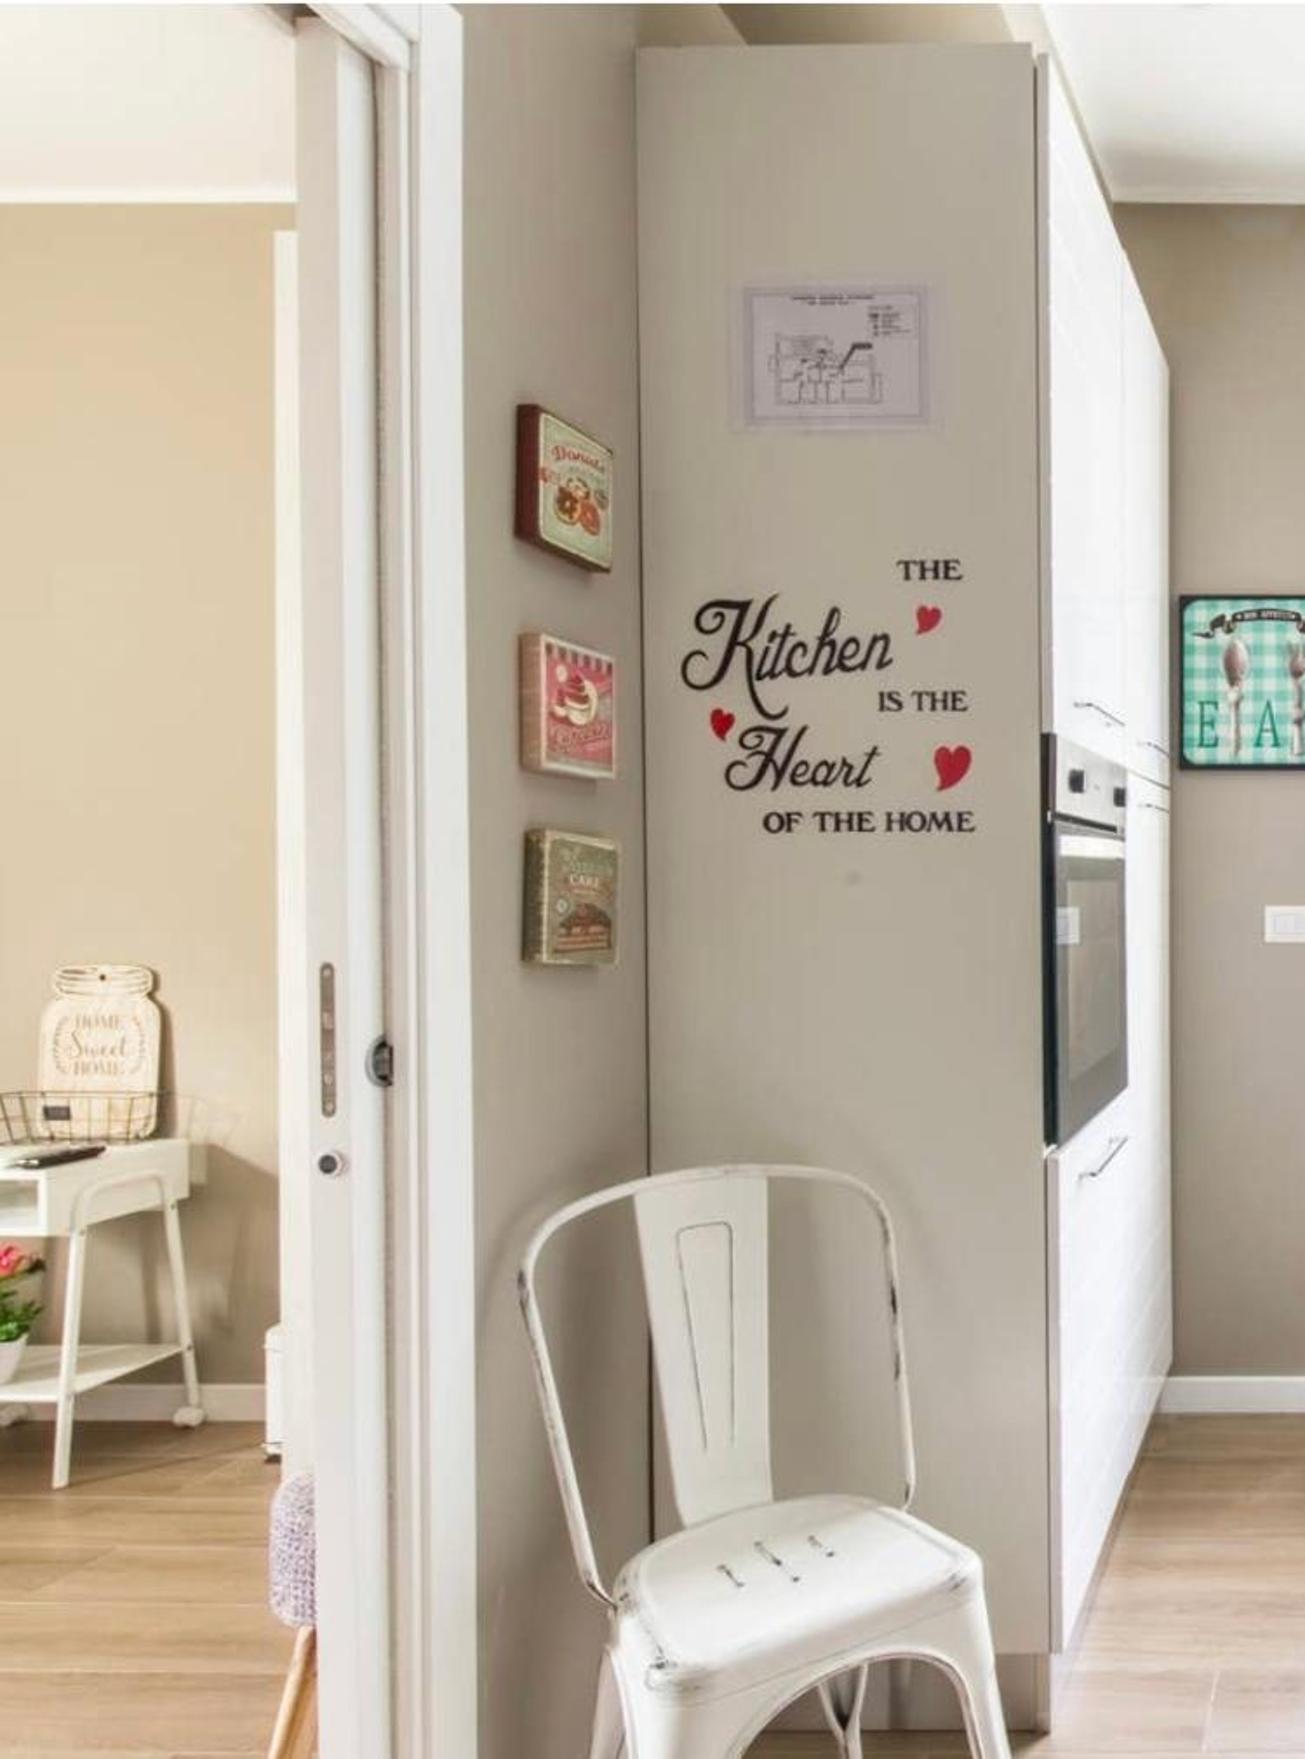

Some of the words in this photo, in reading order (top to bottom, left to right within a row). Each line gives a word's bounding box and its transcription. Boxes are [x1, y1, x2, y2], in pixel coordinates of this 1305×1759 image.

[896, 559, 964, 582] THE
[681, 593, 894, 721] Kitchen
[877, 690, 904, 712] IS
[911, 690, 969, 712] THE
[724, 724, 881, 792] Heart
[763, 811, 804, 834] OF
[812, 811, 876, 833] THE
[884, 811, 977, 833] HOME
